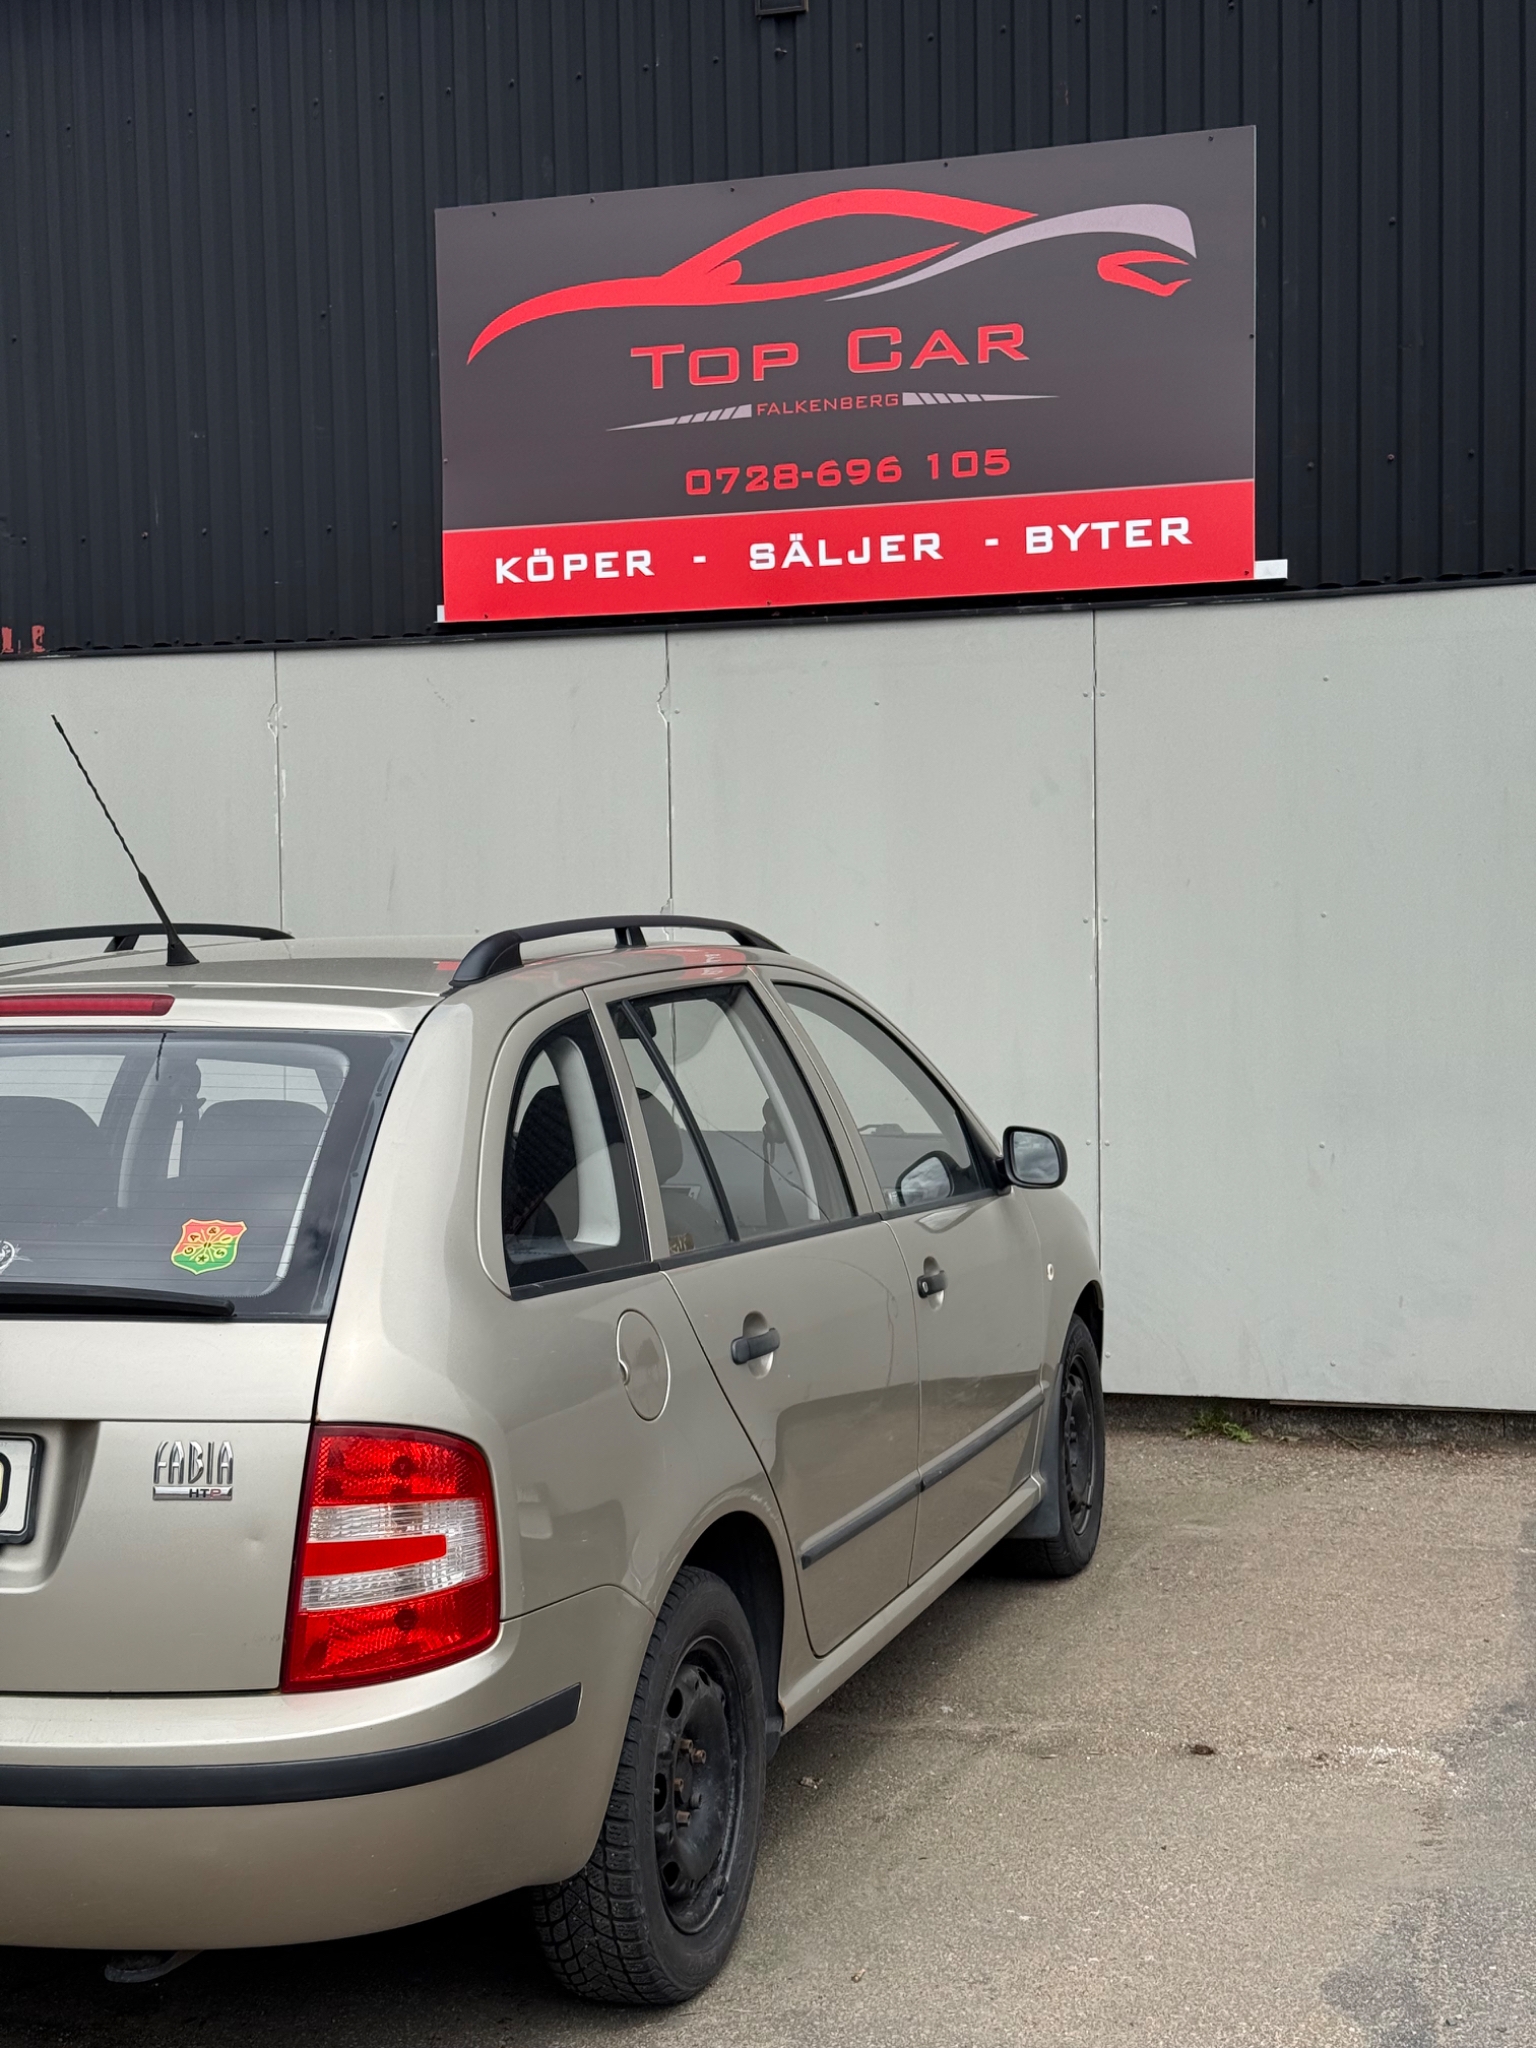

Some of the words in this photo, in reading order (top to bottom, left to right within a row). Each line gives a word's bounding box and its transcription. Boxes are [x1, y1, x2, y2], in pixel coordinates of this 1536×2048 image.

[630, 341, 799, 389] TOP
[847, 323, 1029, 374] CAR
[756, 392, 900, 417] FALKENBERG
[685, 456, 903, 496] 0728-696
[927, 448, 1011, 480] 105
[495, 547, 655, 584] KÖPER
[749, 532, 944, 570] SÄLJER
[1025, 516, 1193, 555] BYTER
[153, 1440, 233, 1485] FABIA
[189, 1488, 222, 1499] HTP
